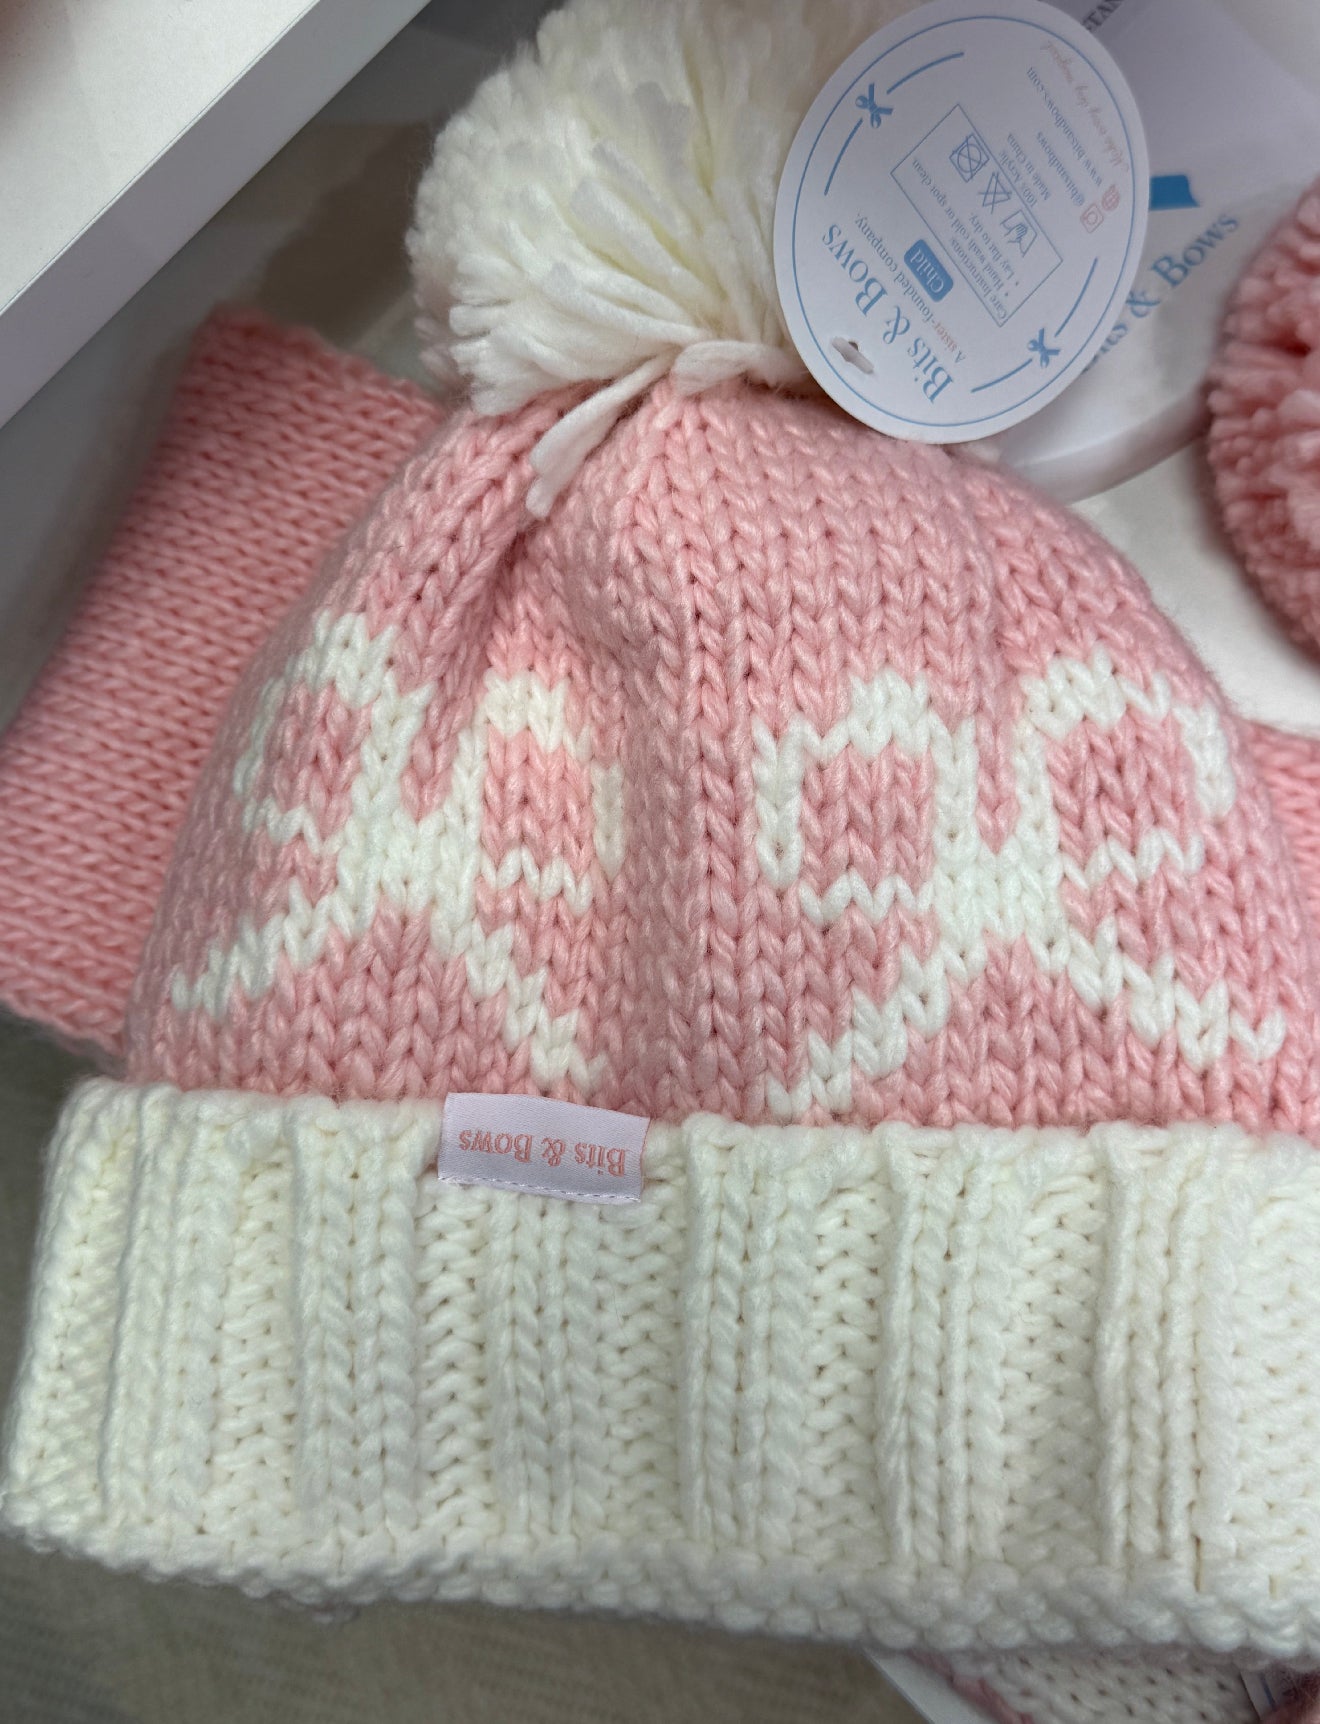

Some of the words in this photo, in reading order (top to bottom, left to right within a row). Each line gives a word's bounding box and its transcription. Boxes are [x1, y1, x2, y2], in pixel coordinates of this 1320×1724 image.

[1024, 65, 1103, 187] www.bitsandbows.com
[1006, 131, 1027, 164] China
[996, 148, 1023, 182] Acrylic
[1024, 160, 1035, 175] in
[1035, 130, 1085, 207] @bitsandbows
[929, 185, 946, 206] spot
[1031, 172, 1052, 200] Made
[944, 207, 955, 219] or
[951, 217, 970, 240] cold
[854, 212, 898, 272] company.
[967, 238, 985, 264] wash
[980, 231, 991, 245] to
[988, 242, 1002, 261] flat
[1151, 214, 1239, 287] Bows
[819, 223, 888, 317] Bows
[909, 248, 945, 294] Child
[982, 262, 1004, 290] Hand
[999, 260, 1015, 280] Lay
[893, 270, 957, 352] sister-founded
[989, 294, 1008, 319] Care
[883, 303, 910, 344] &
[905, 336, 953, 404] Bits
[954, 350, 966, 360] A
[458, 1129, 533, 1163] Bows
[541, 1138, 566, 1167] &
[575, 1143, 626, 1177] Bits
